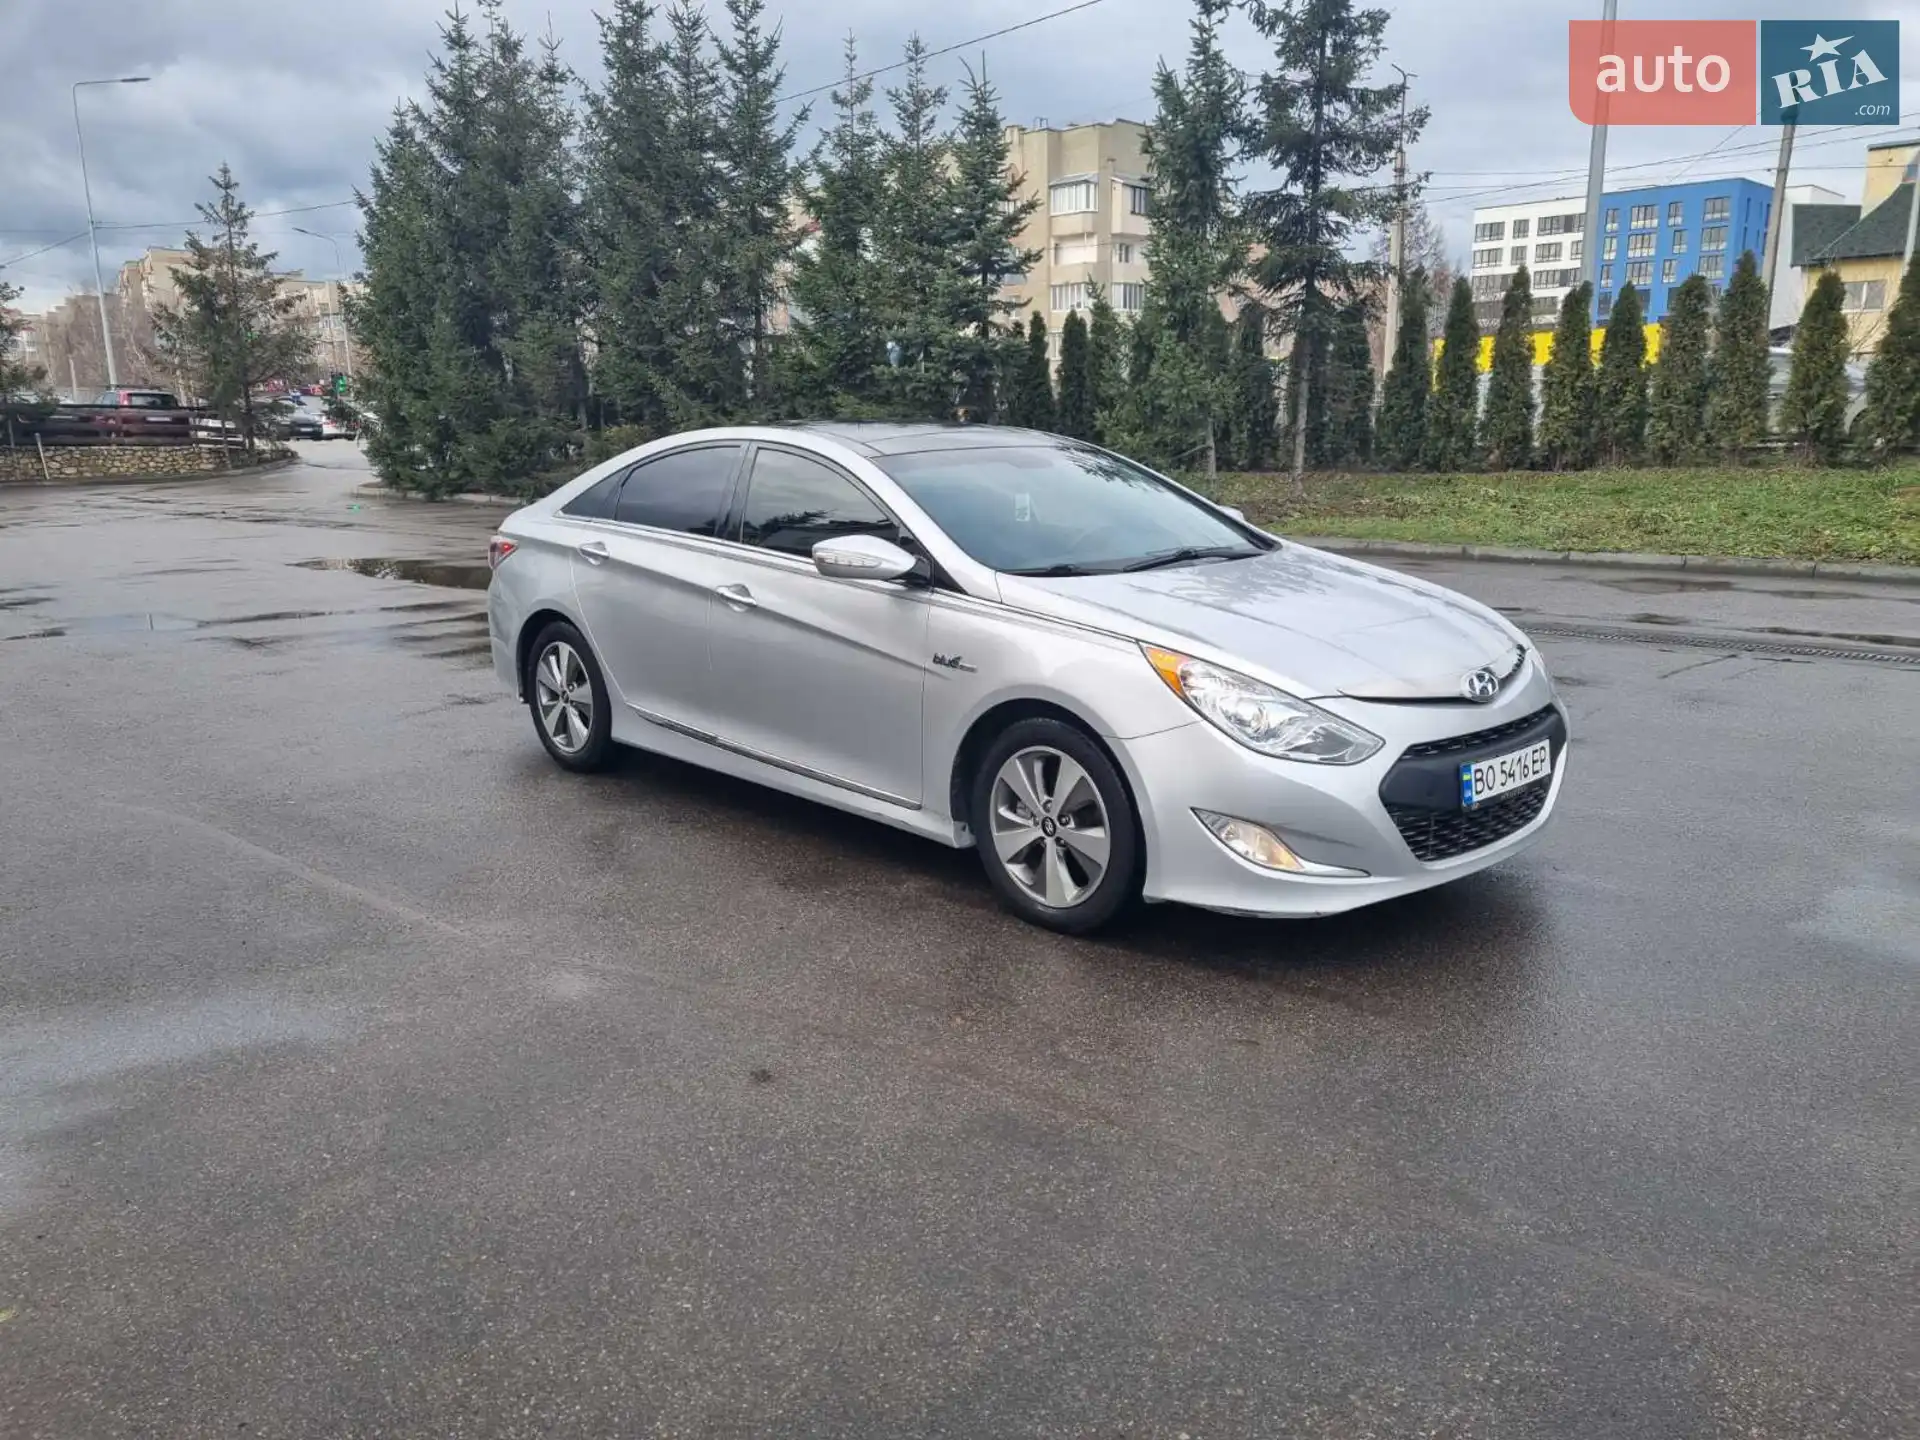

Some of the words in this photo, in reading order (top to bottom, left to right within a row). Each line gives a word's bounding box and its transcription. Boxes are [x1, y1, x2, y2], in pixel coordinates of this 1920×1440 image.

[1474, 765, 1496, 795] BO
[1500, 752, 1530, 787] 5416
[1531, 745, 1547, 775] EP
